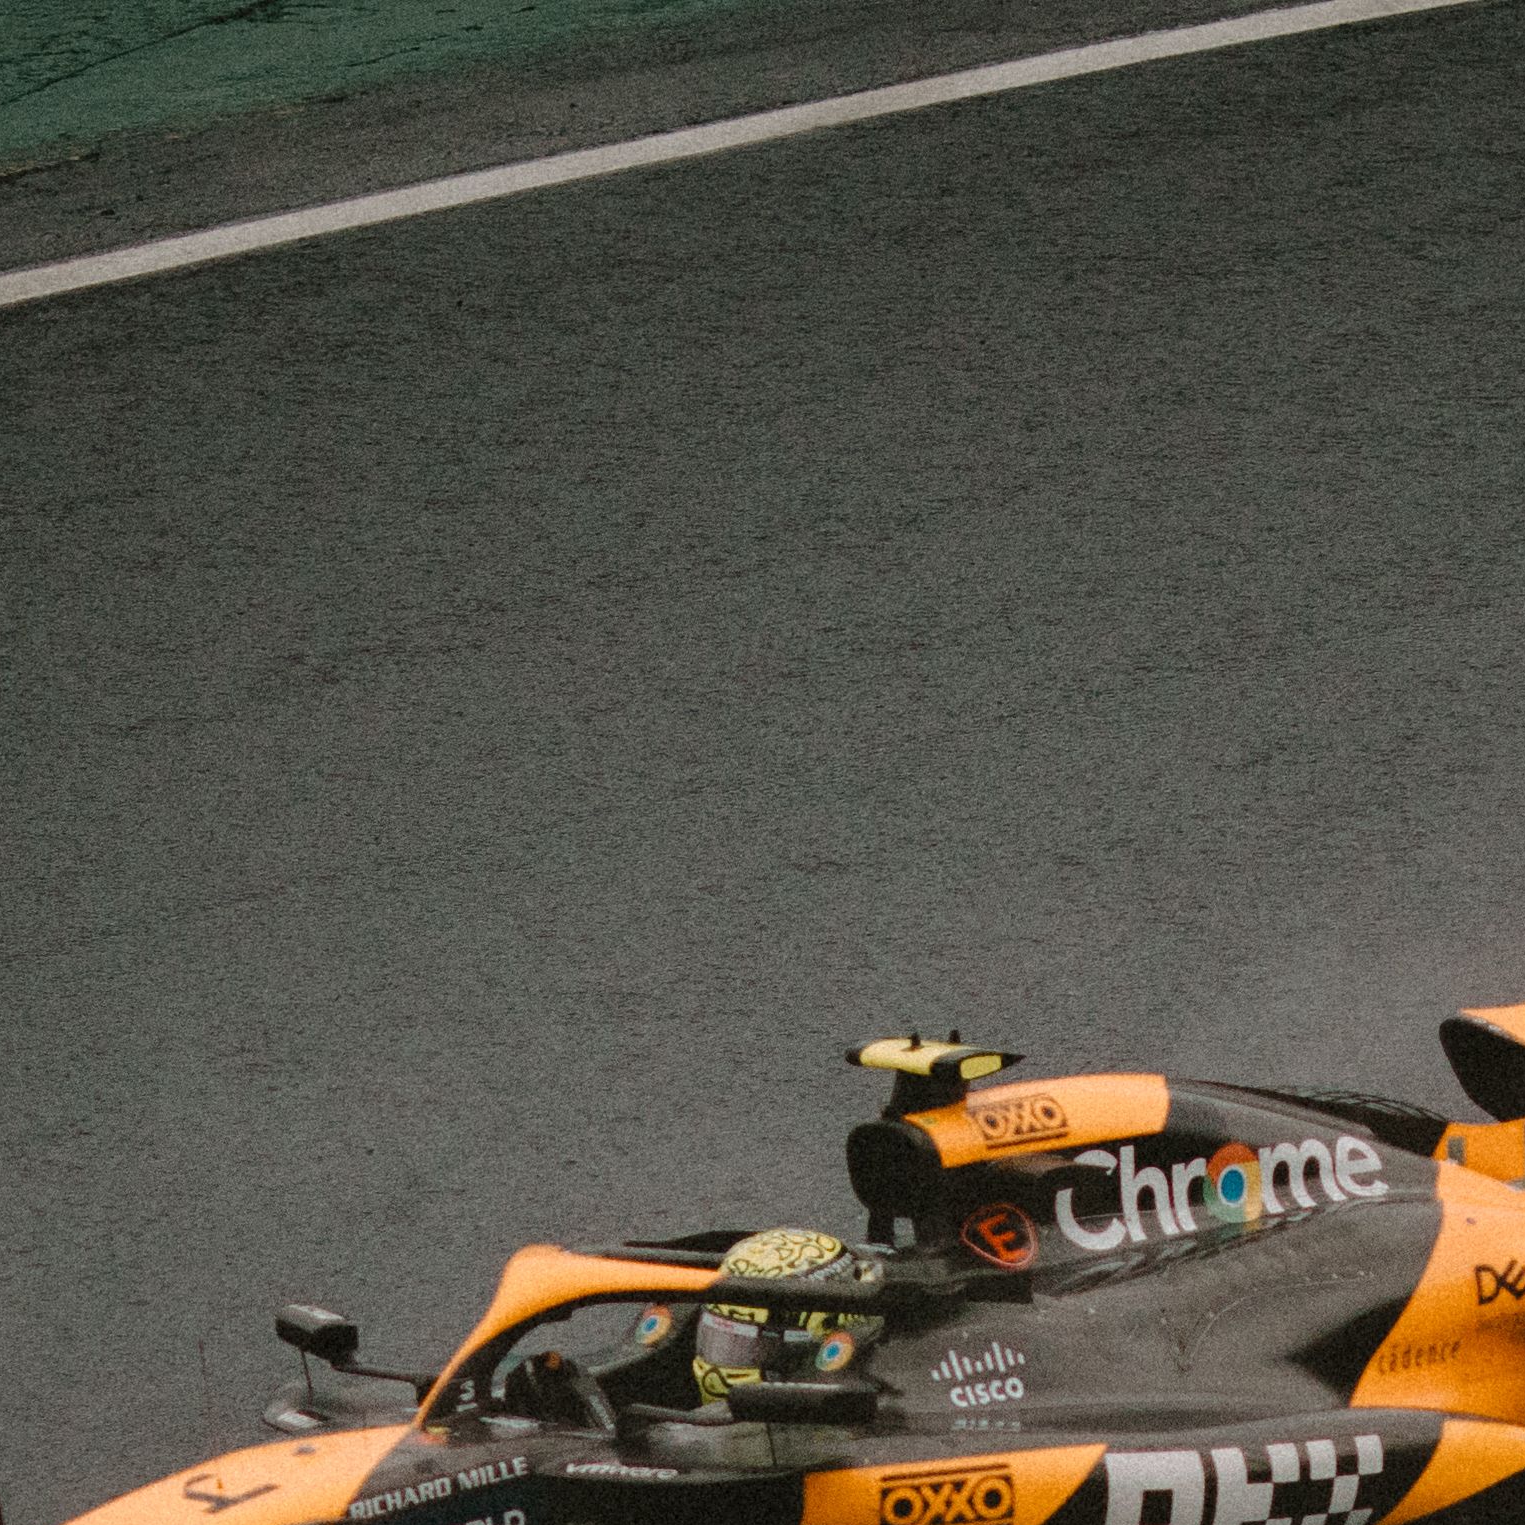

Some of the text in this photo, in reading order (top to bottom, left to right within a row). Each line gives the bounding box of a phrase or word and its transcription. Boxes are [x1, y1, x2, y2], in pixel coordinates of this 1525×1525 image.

[975, 1097, 1066, 1140] OXXO
[349, 1456, 528, 1520] RICHARD MILLE
